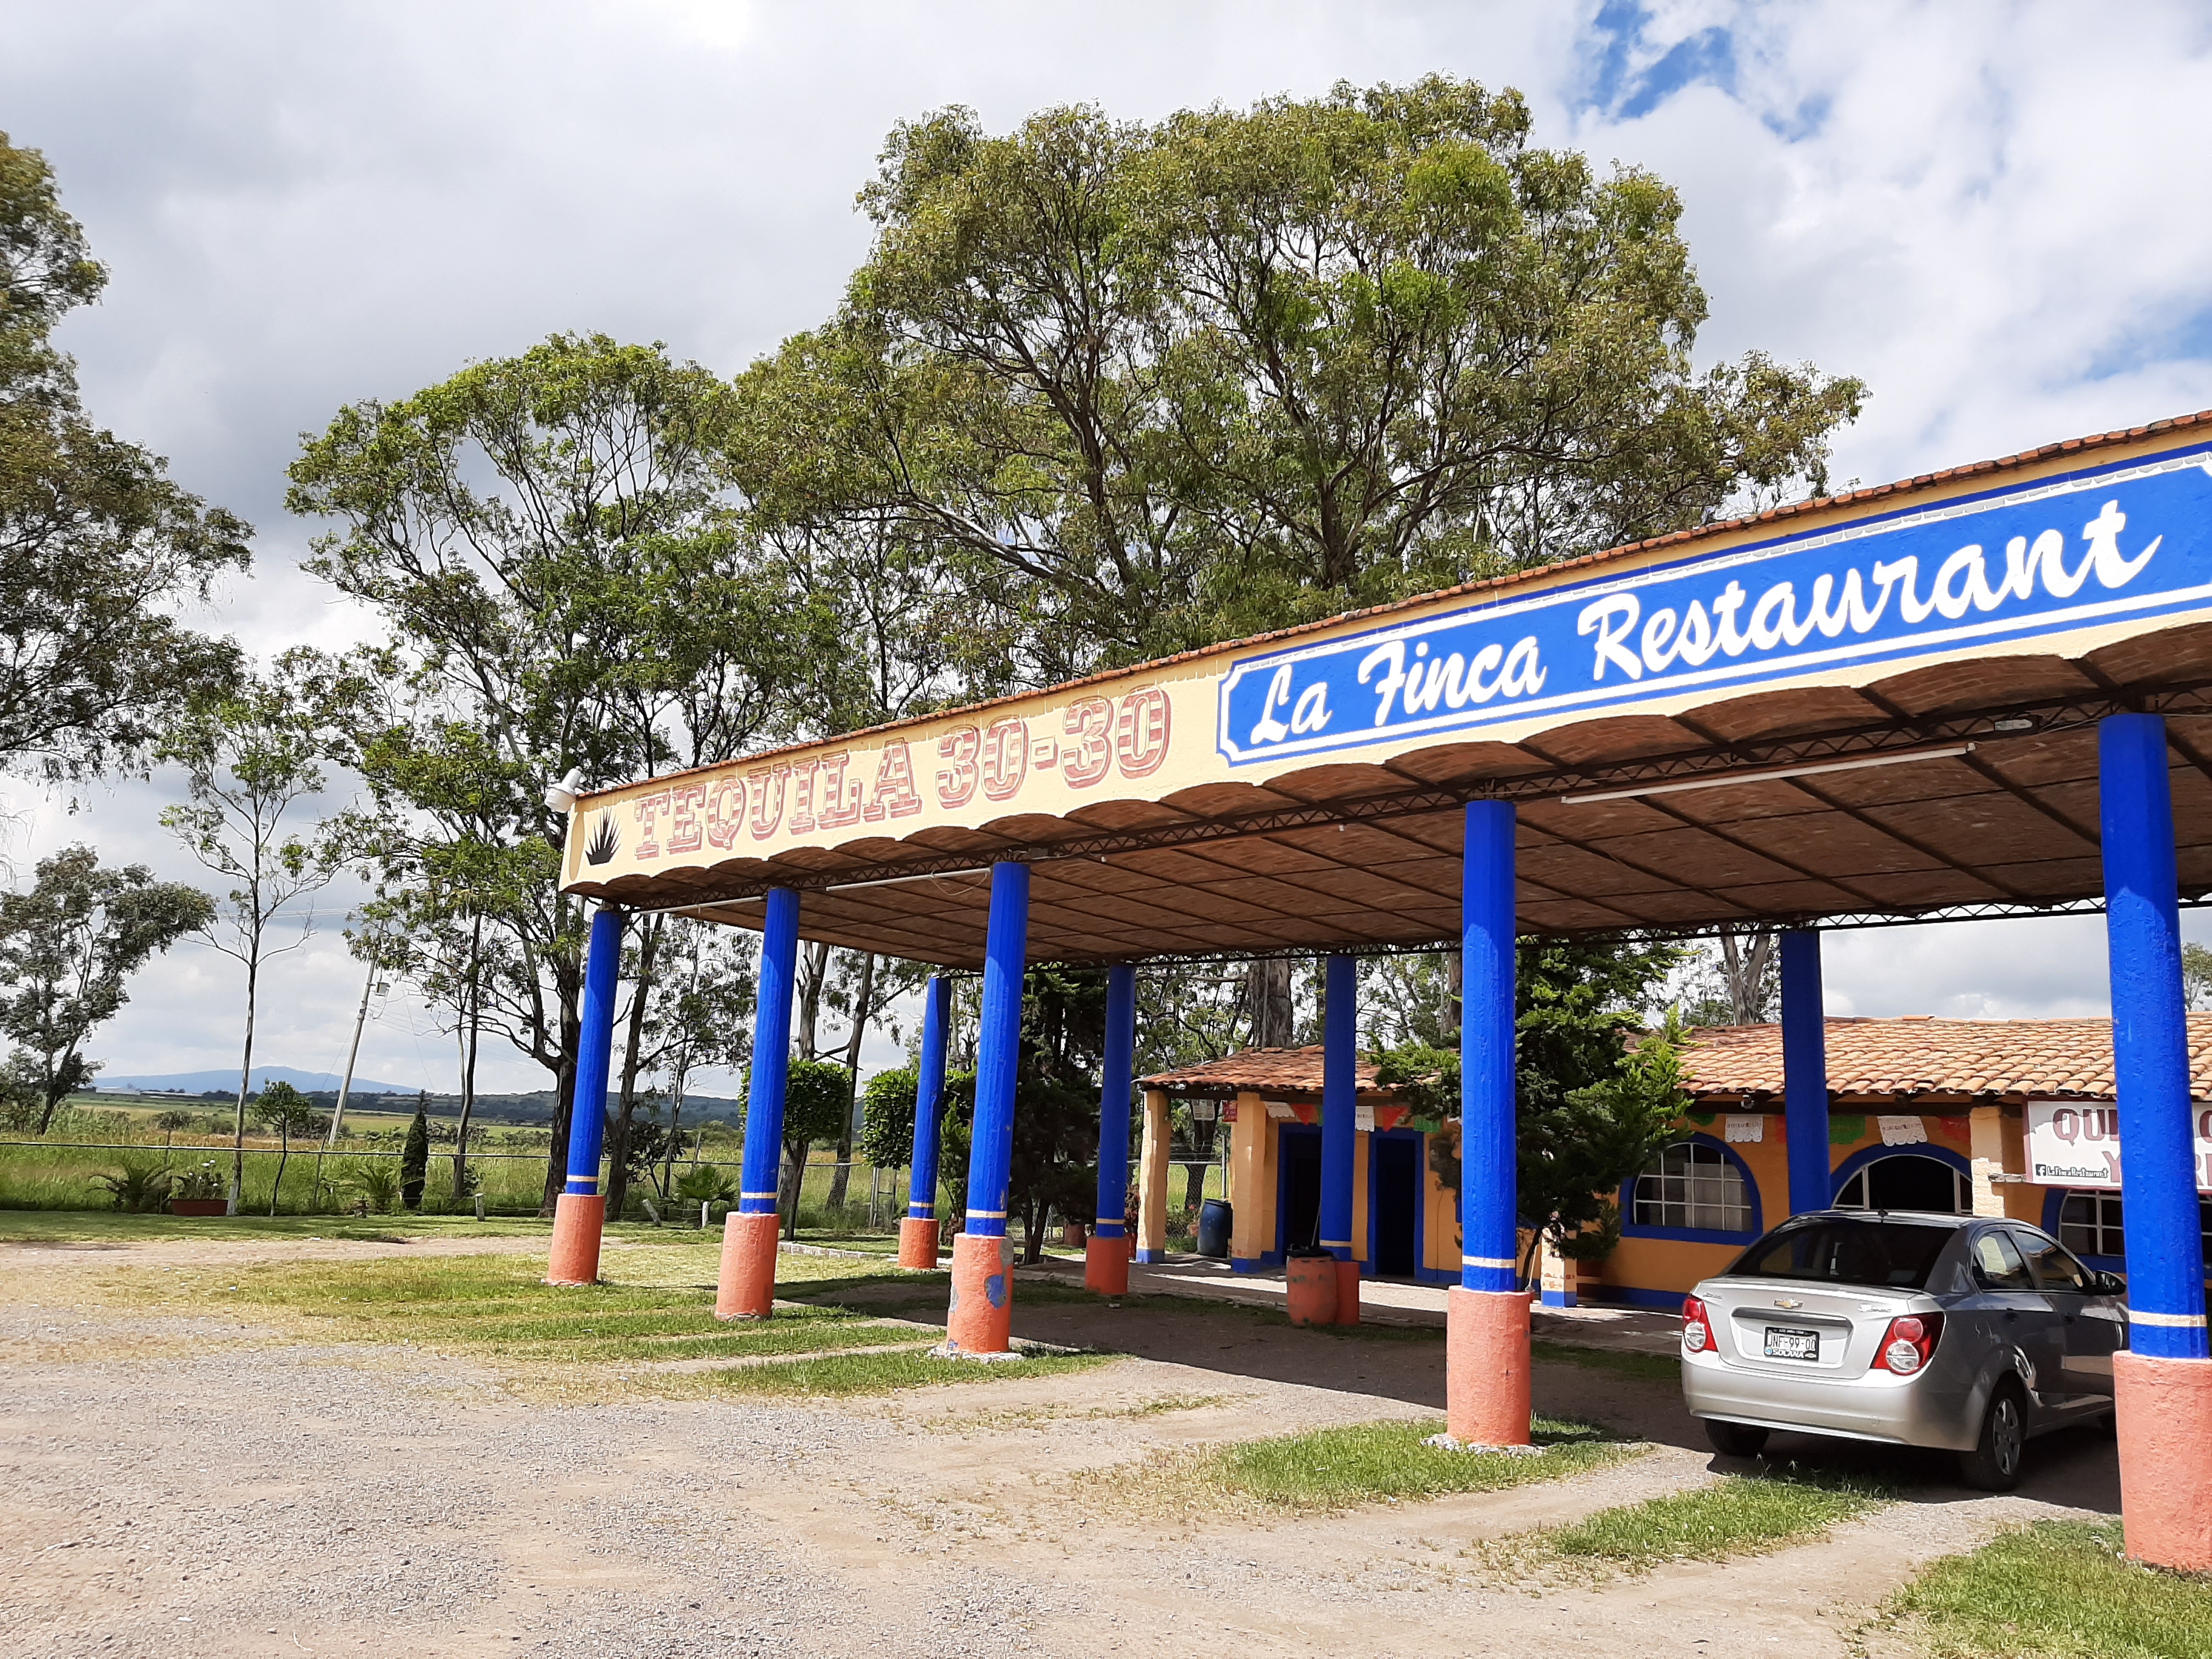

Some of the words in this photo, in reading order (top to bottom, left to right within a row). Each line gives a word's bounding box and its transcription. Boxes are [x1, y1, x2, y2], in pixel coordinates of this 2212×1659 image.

[1250, 664, 1333, 744] La
[1357, 636, 1547, 727] Finca
[1578, 499, 2163, 681] Restaurant
[634, 737, 923, 861] TEQUILA
[935, 684, 1172, 810] 30-30
